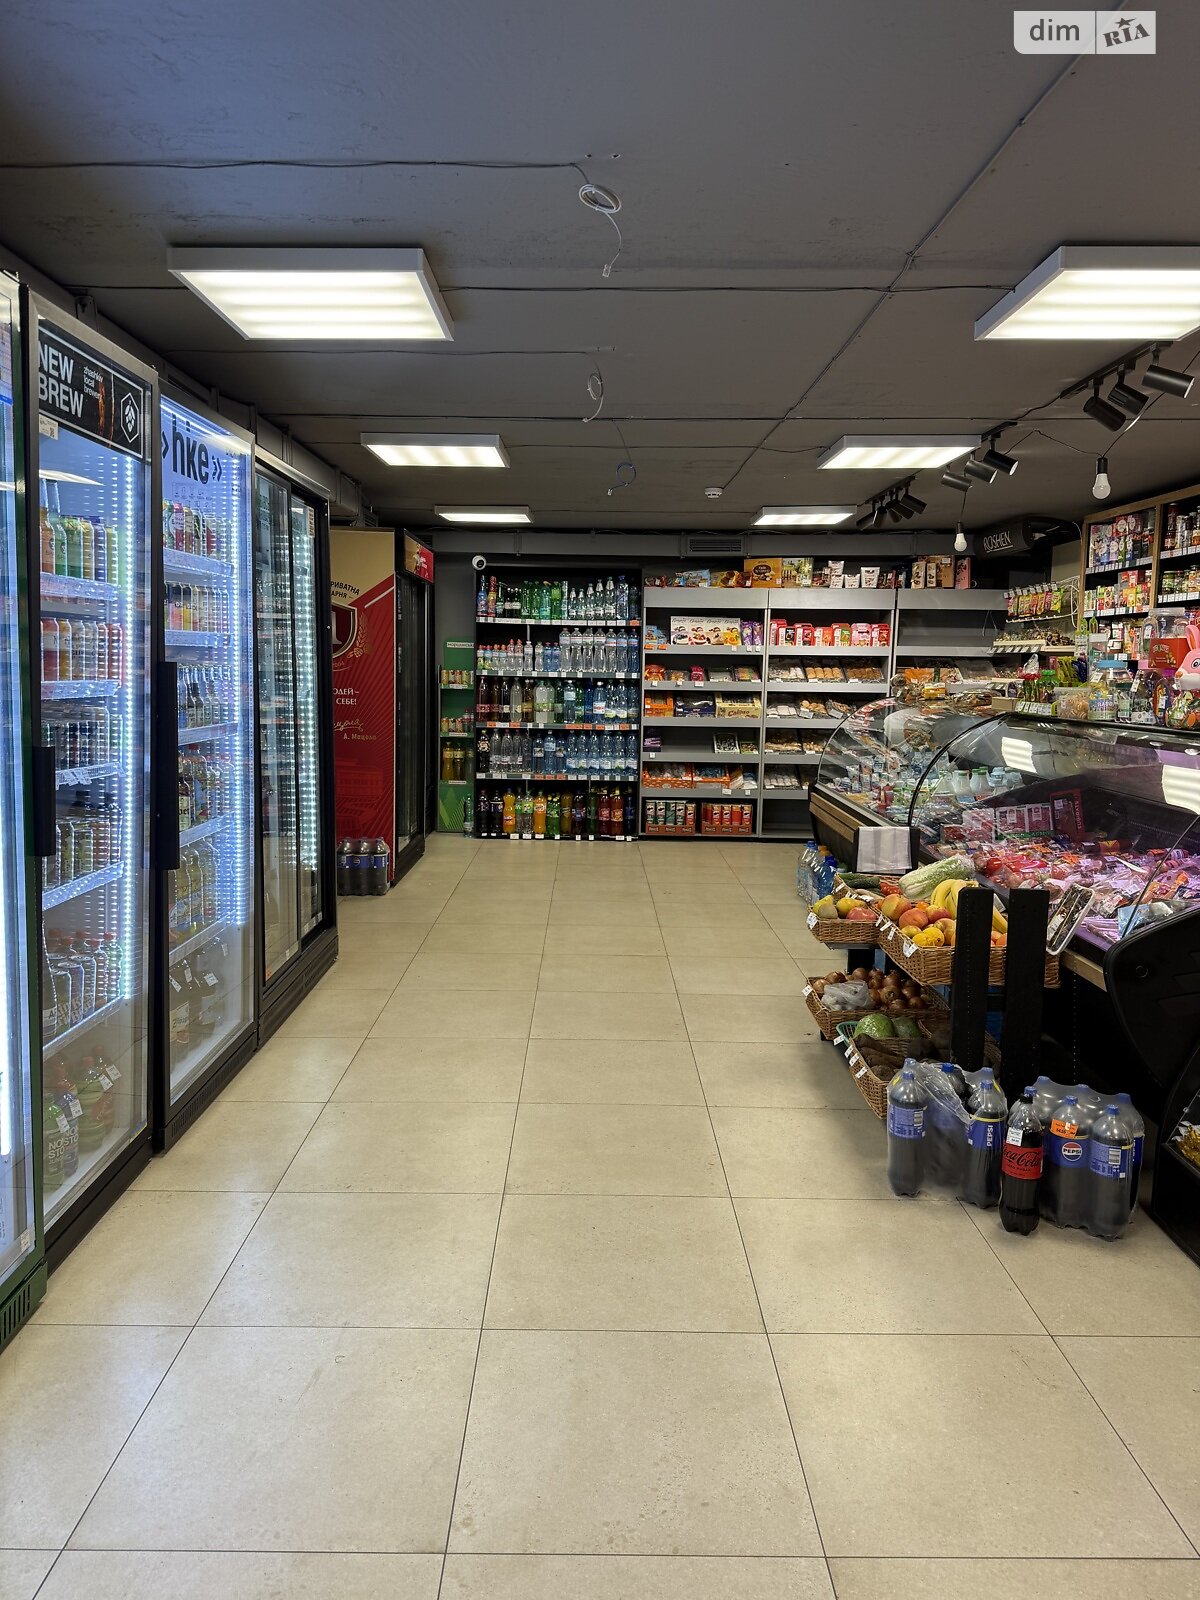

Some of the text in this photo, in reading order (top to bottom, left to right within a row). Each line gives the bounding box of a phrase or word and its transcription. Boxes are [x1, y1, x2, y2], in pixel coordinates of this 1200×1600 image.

[38, 343, 74, 384] NEW
[83, 374, 95, 388] local
[38, 373, 84, 418] BREW
[983, 530, 1012, 551] ROSHEN
[335, 697, 357, 706] СЕБЕ!
[986, 1124, 994, 1147] PEPSI
